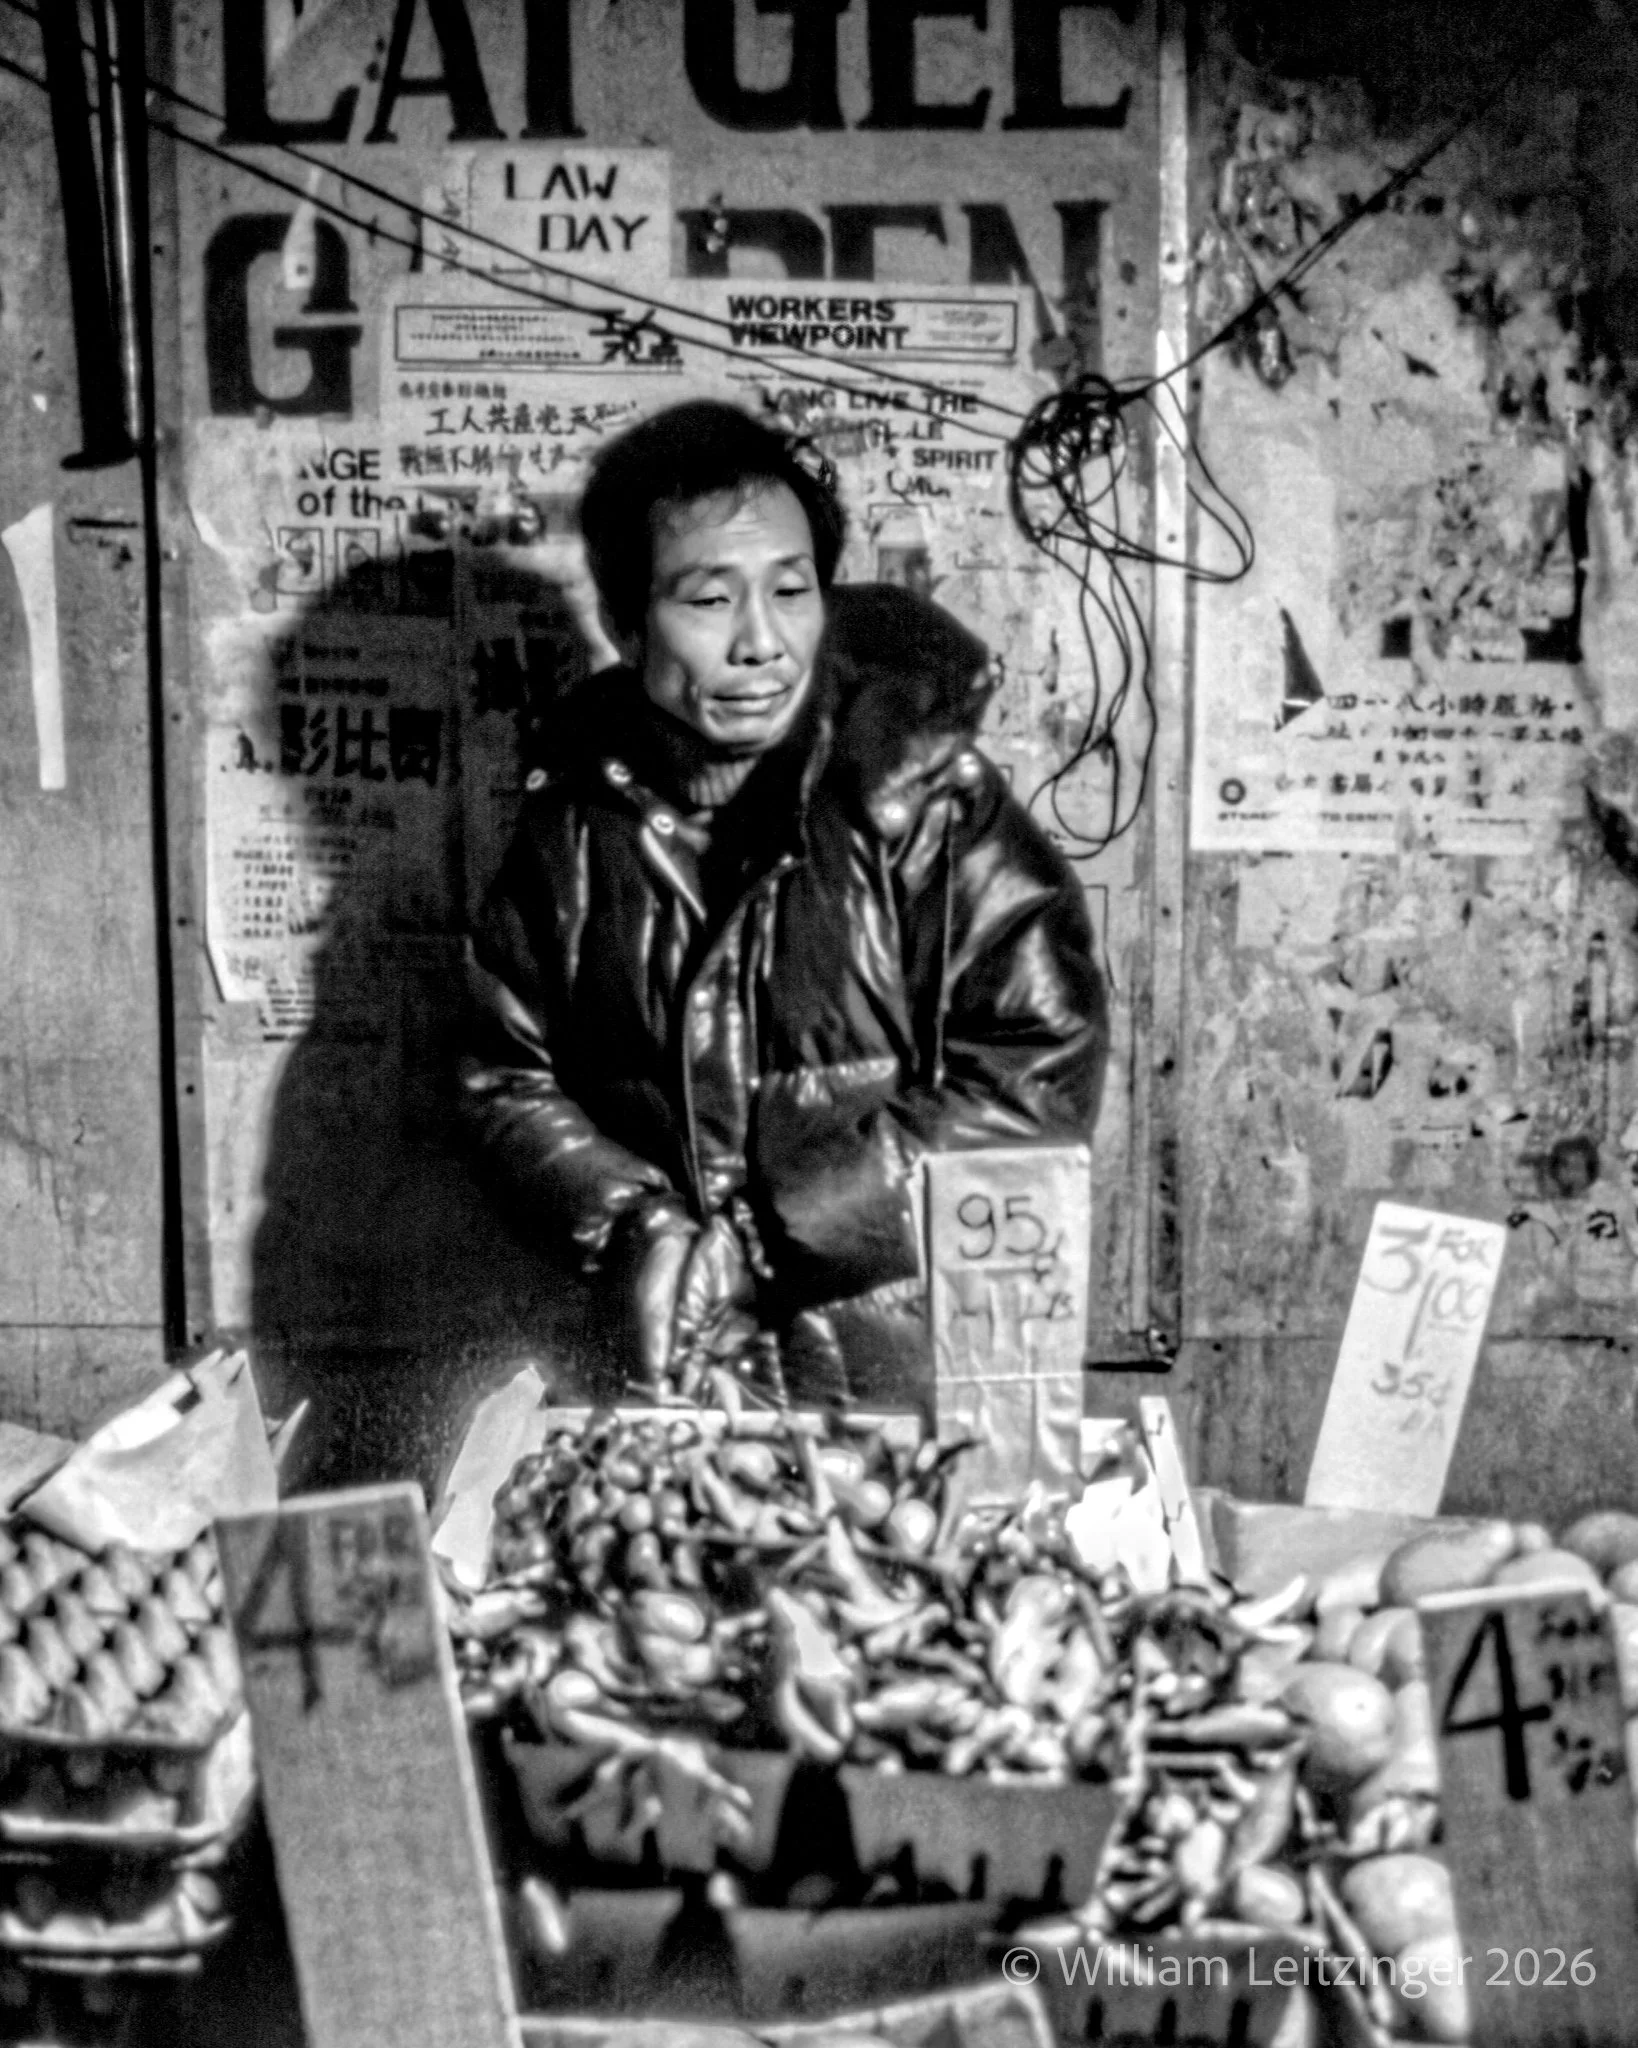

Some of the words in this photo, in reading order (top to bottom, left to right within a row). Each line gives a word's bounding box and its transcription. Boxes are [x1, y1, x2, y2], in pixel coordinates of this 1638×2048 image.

[505, 162, 618, 201] LAW
[538, 214, 649, 253] DAY
[727, 295, 895, 322] WORKERS
[727, 322, 909, 350] VIEWPOINT
[913, 450, 998, 470] SPIRIT
[297, 486, 335, 517] of
[1361, 1220, 1432, 1295] 3
[236, 1515, 356, 1712] 4
[1440, 1609, 1553, 1802] 4
